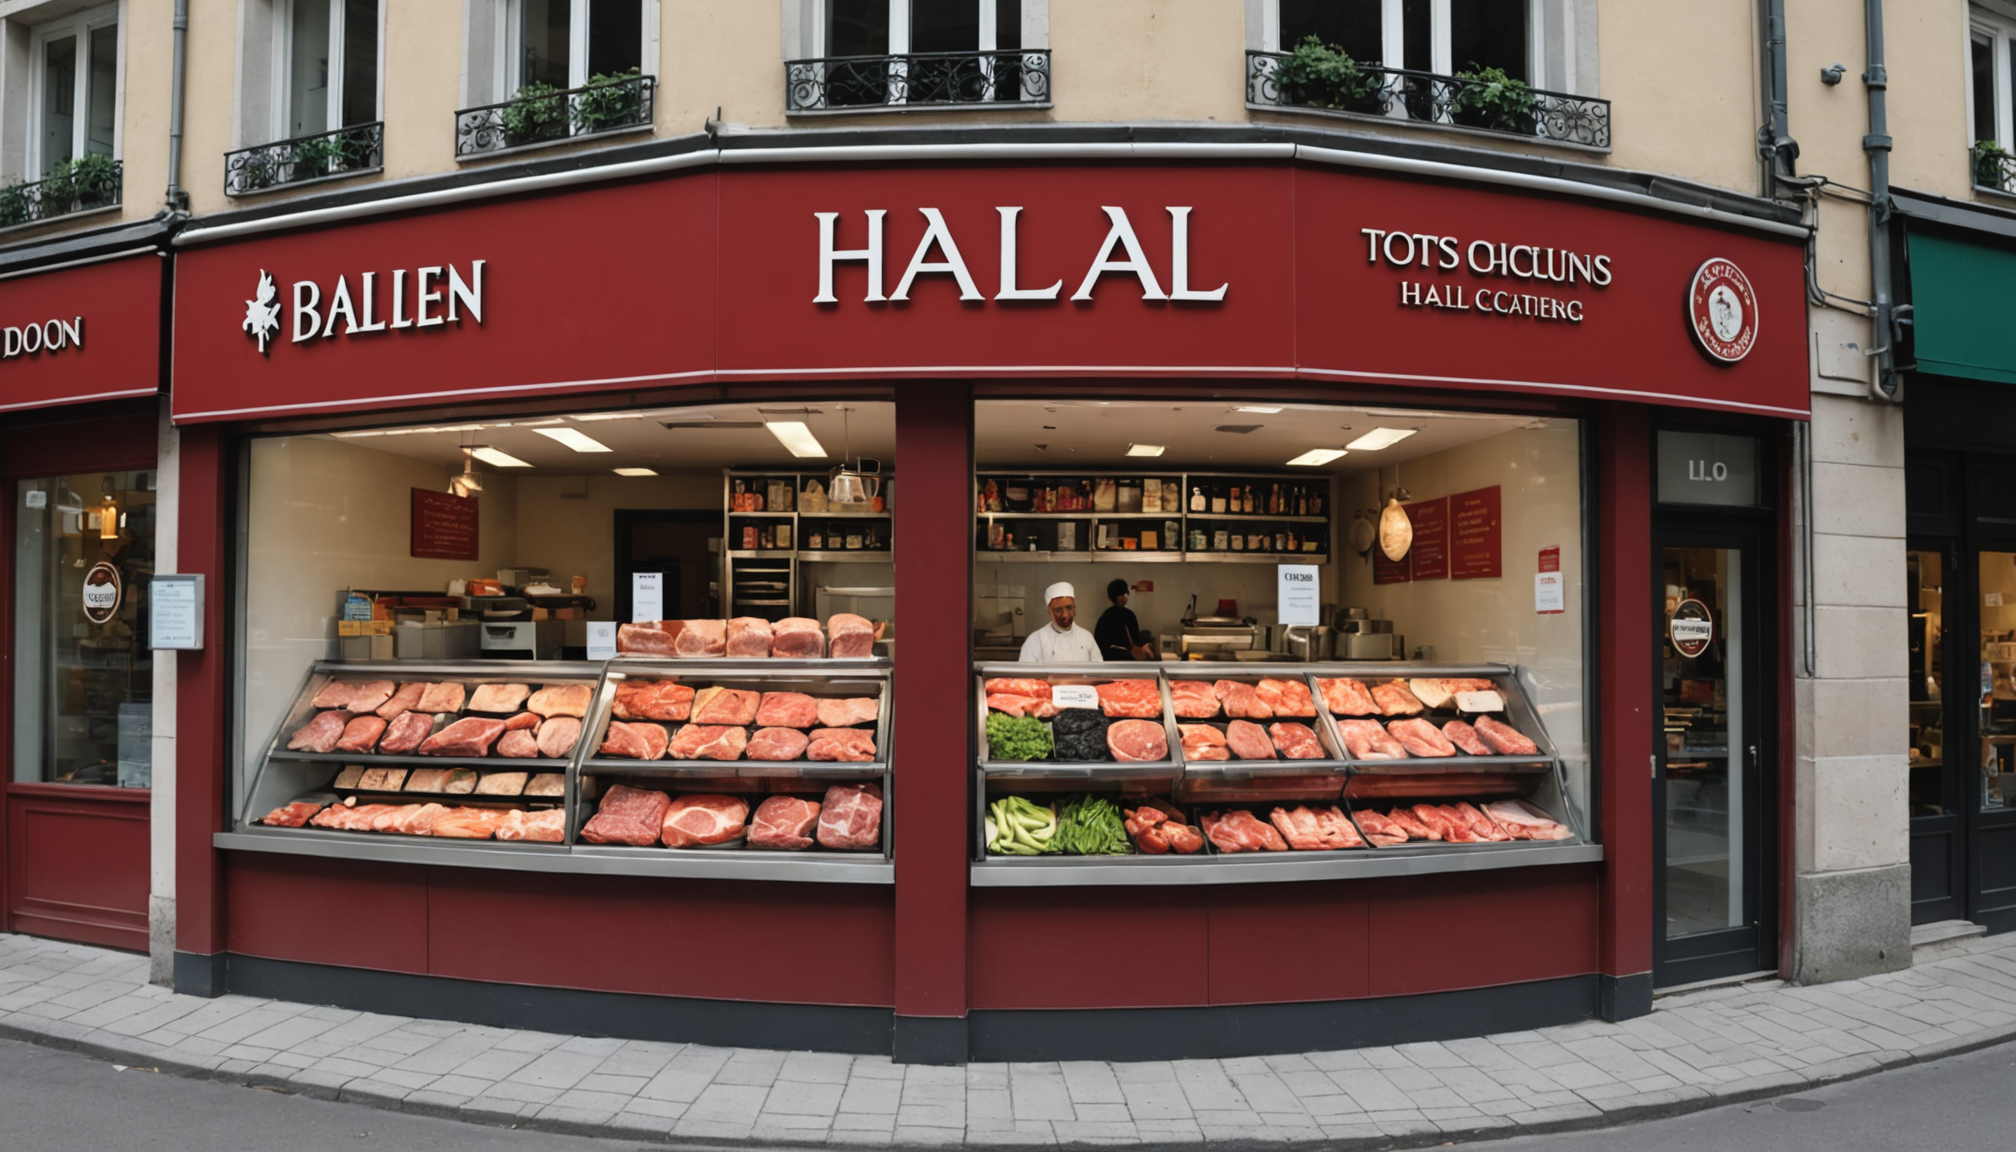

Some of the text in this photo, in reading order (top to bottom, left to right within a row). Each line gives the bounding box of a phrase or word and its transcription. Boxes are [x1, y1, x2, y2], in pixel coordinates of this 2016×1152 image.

[812, 205, 1229, 303] HALAL
[1361, 228, 1460, 269] TOTS
[292, 259, 486, 343] BALLEN
[1401, 281, 1470, 309] HALL
[3, 315, 82, 358] DOON
